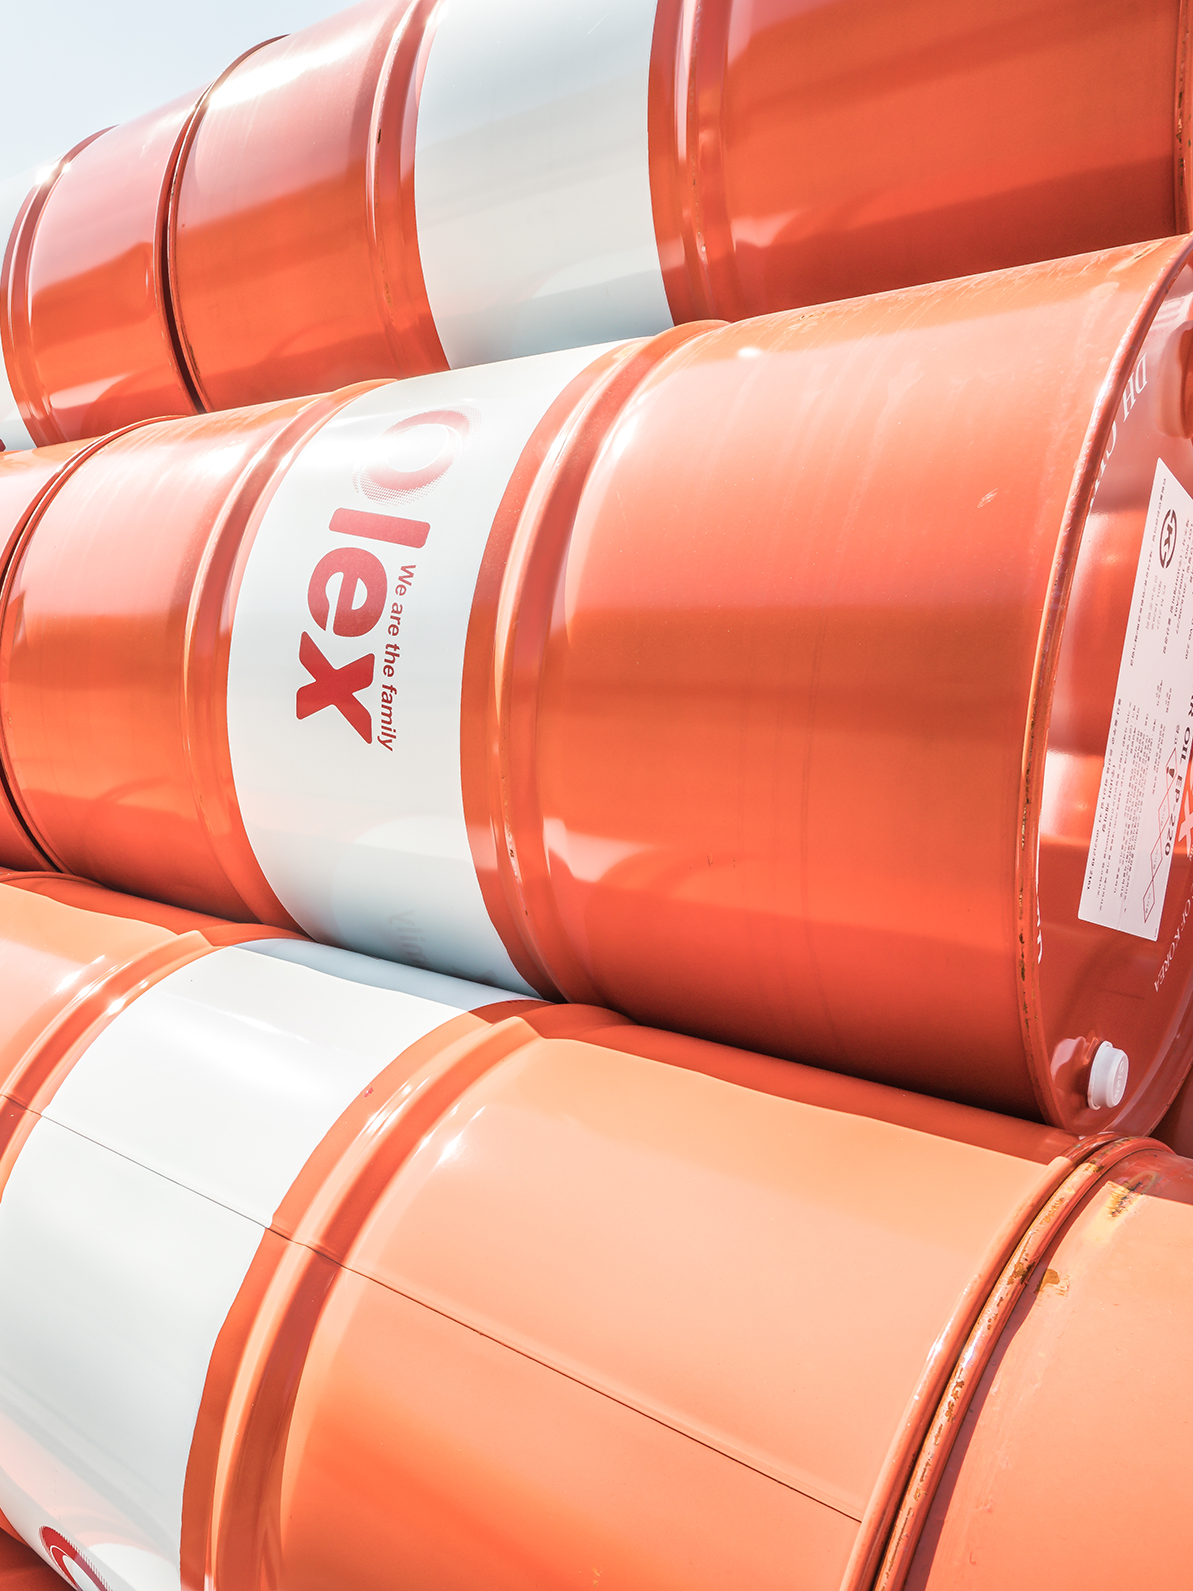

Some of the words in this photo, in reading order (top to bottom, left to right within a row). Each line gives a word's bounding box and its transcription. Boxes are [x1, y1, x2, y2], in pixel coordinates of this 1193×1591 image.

[1122, 353, 1148, 422] DH
[296, 407, 471, 745] Olex
[392, 563, 417, 597] We
[386, 601, 405, 637] are
[379, 643, 400, 678] the
[376, 684, 400, 752] family
[1179, 725, 1191, 767] OIL
[1163, 773, 1183, 857] EP-220
[1153, 927, 1181, 993] KOREA
